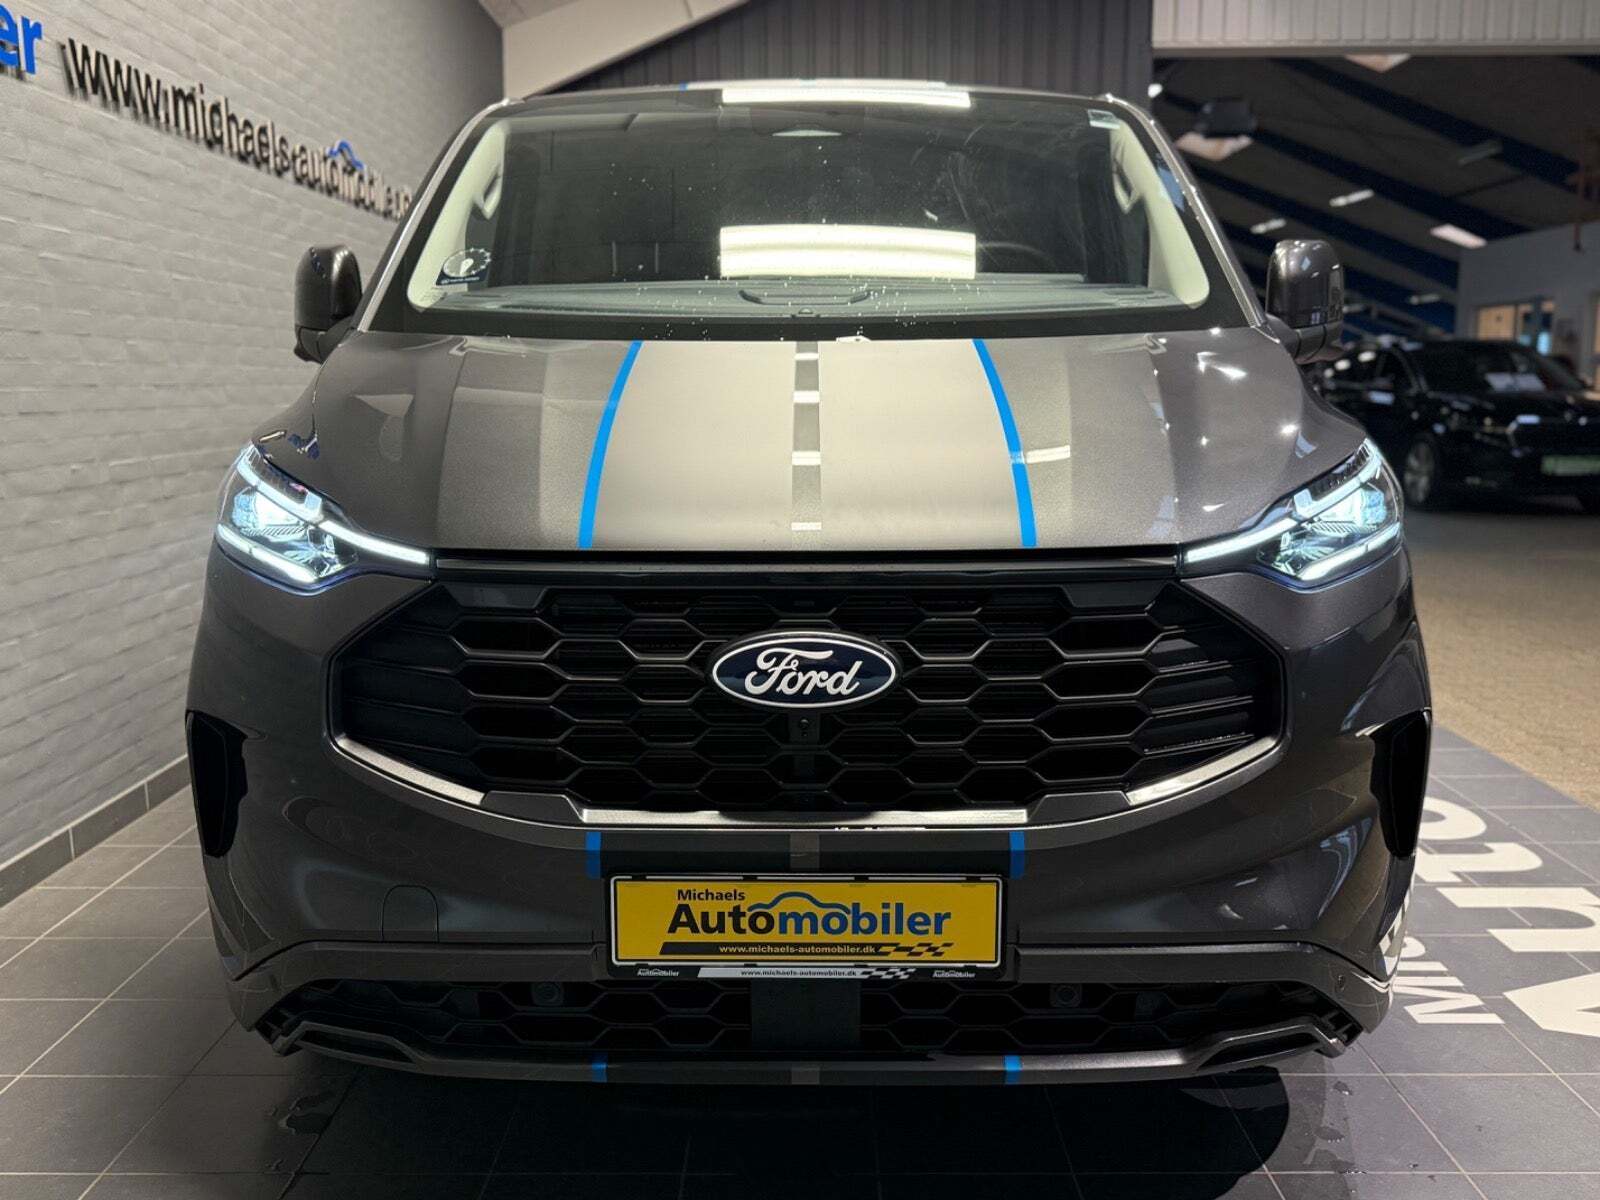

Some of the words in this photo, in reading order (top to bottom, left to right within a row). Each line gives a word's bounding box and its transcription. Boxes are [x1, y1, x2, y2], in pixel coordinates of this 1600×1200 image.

[745, 647, 863, 695] Ford
[677, 889, 746, 901] Michaels
[667, 902, 952, 935] Automobiler
[719, 945, 876, 955] www.michaels-automobiler.dk
[740, 969, 857, 977] www.michaels-automobiler.dk
